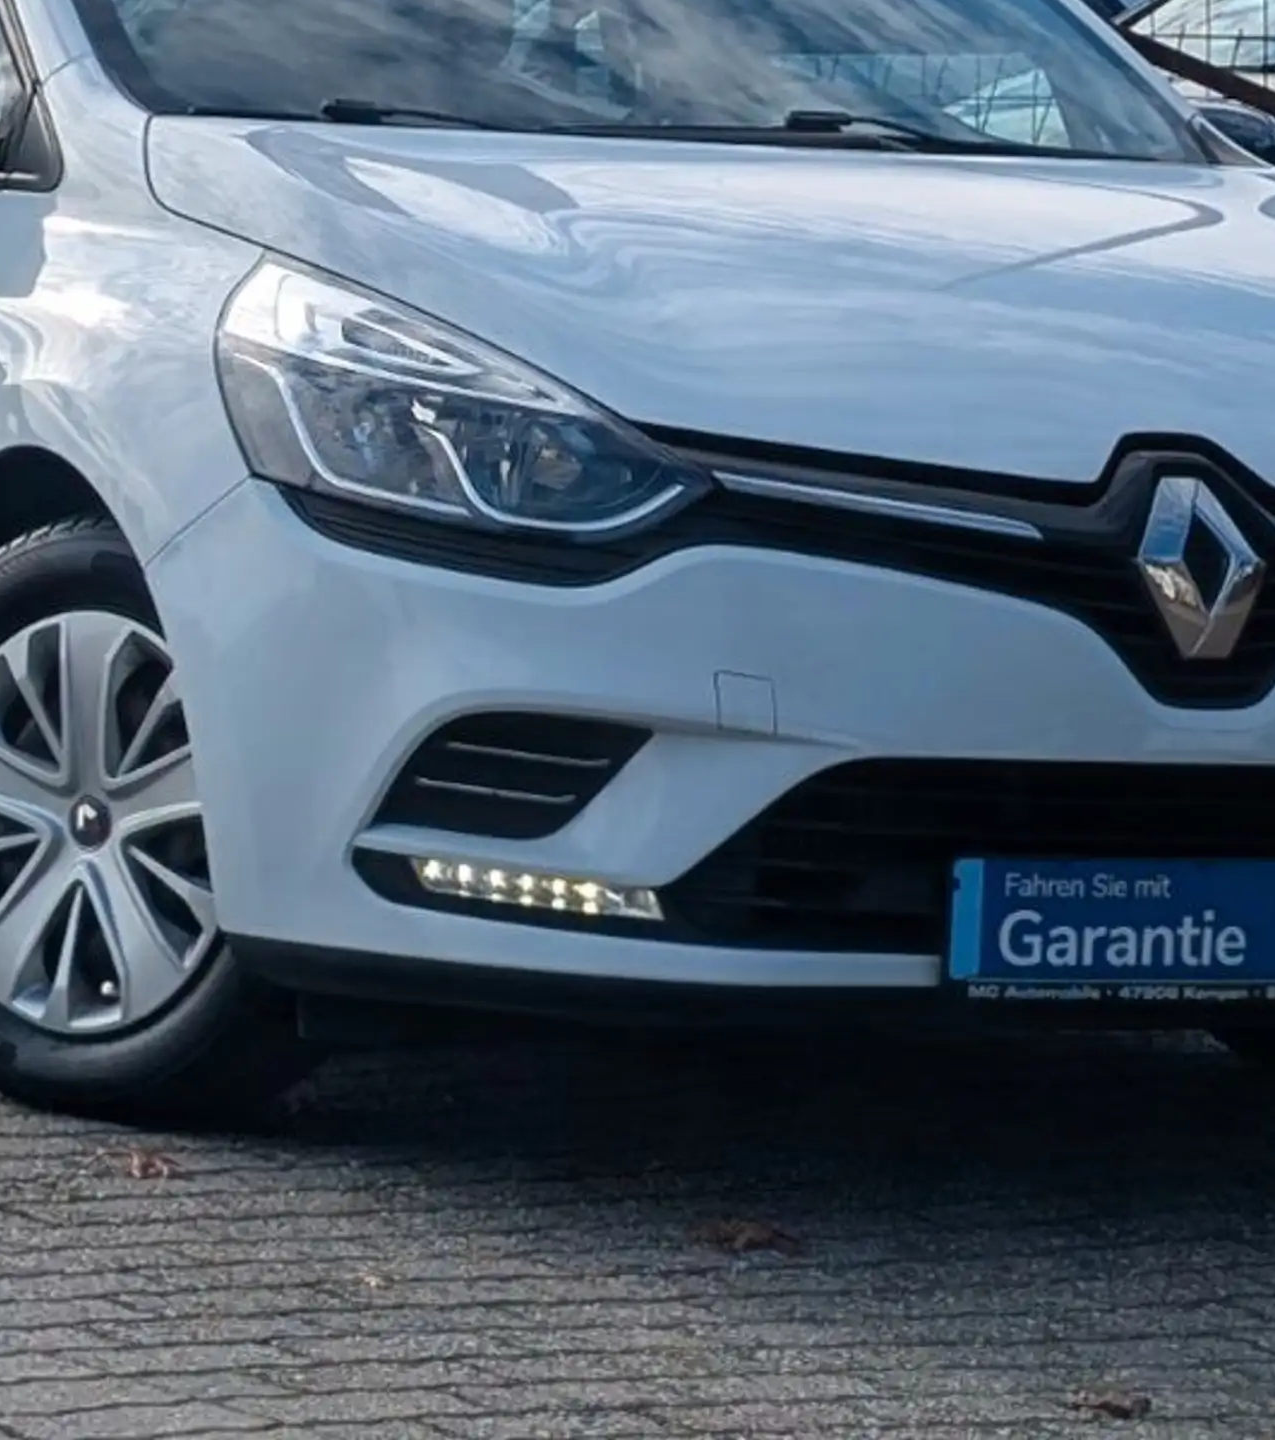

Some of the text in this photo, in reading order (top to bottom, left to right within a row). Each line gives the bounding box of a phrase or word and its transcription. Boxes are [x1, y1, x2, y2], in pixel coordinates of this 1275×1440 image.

[1004, 872, 1172, 899] Fahren Sie mit
[997, 909, 1247, 968] Garantie
